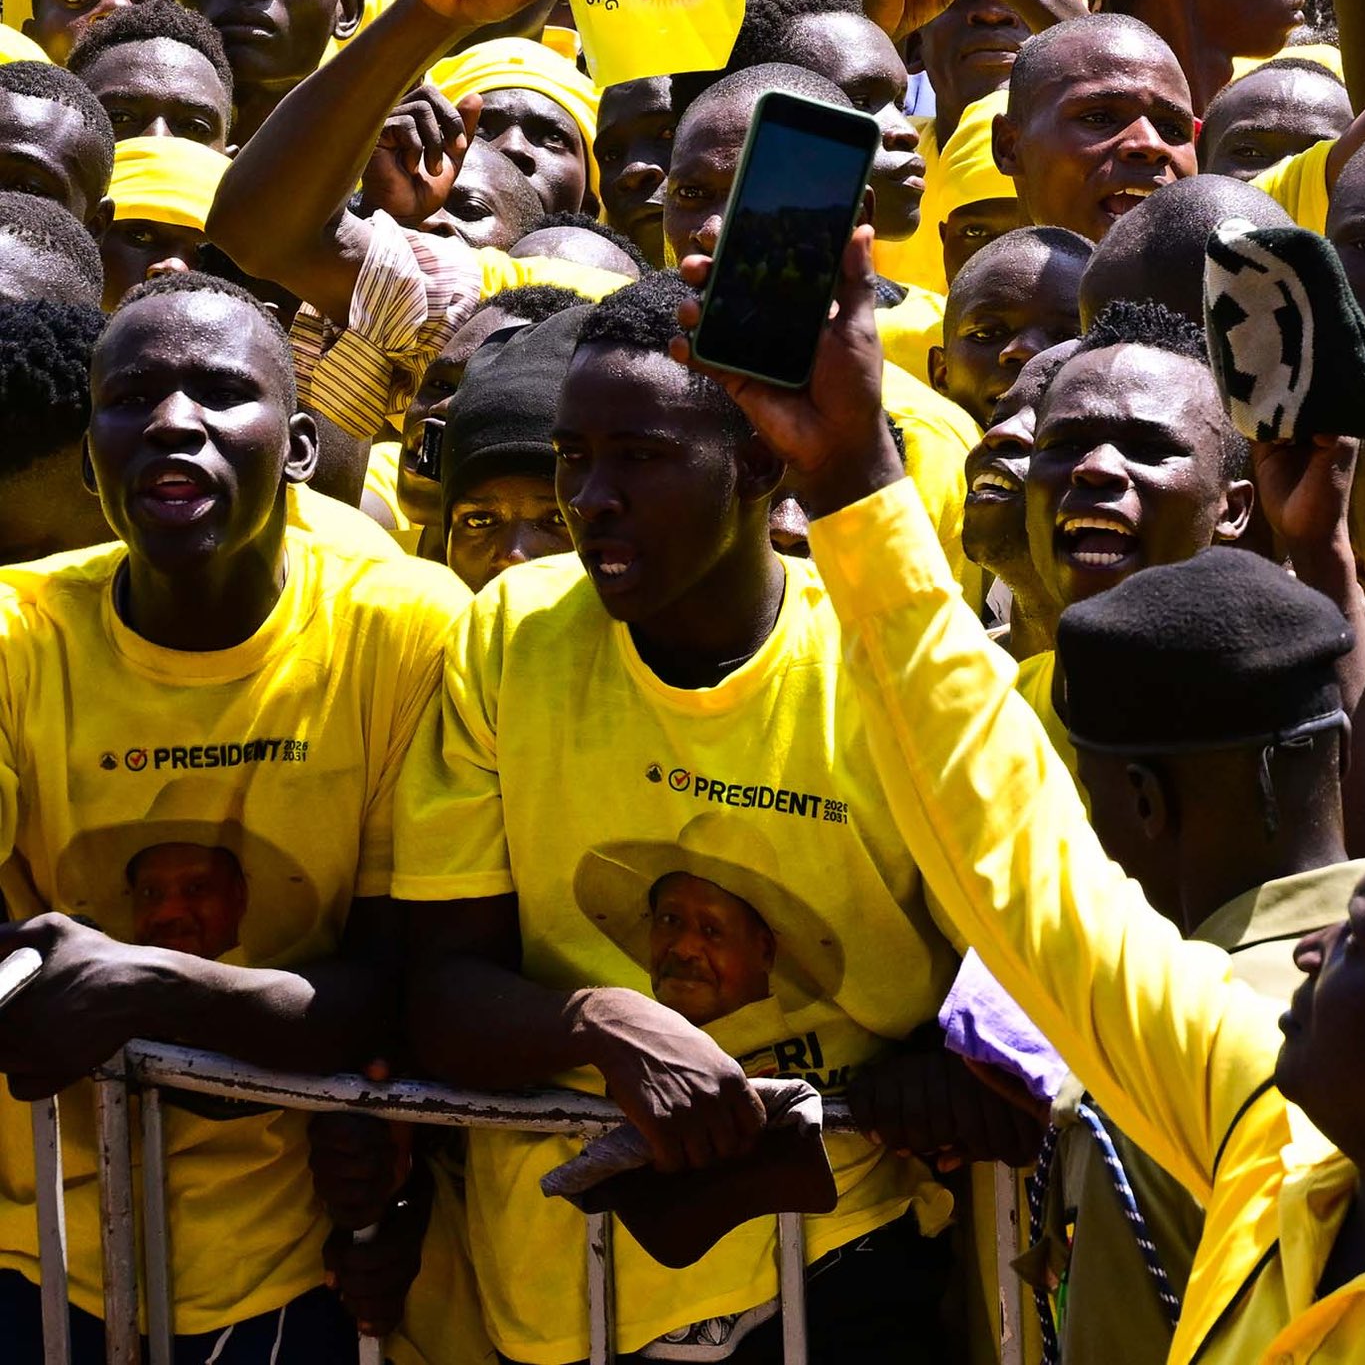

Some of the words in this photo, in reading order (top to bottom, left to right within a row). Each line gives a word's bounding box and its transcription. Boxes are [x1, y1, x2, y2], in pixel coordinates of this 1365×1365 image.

[283, 740, 308, 751] 2026
[154, 738, 282, 770] PRESIDENT
[282, 750, 307, 762] 2031
[694, 776, 822, 819] PRESIDENT
[824, 798, 849, 814] 2026
[823, 810, 849, 824] 2031
